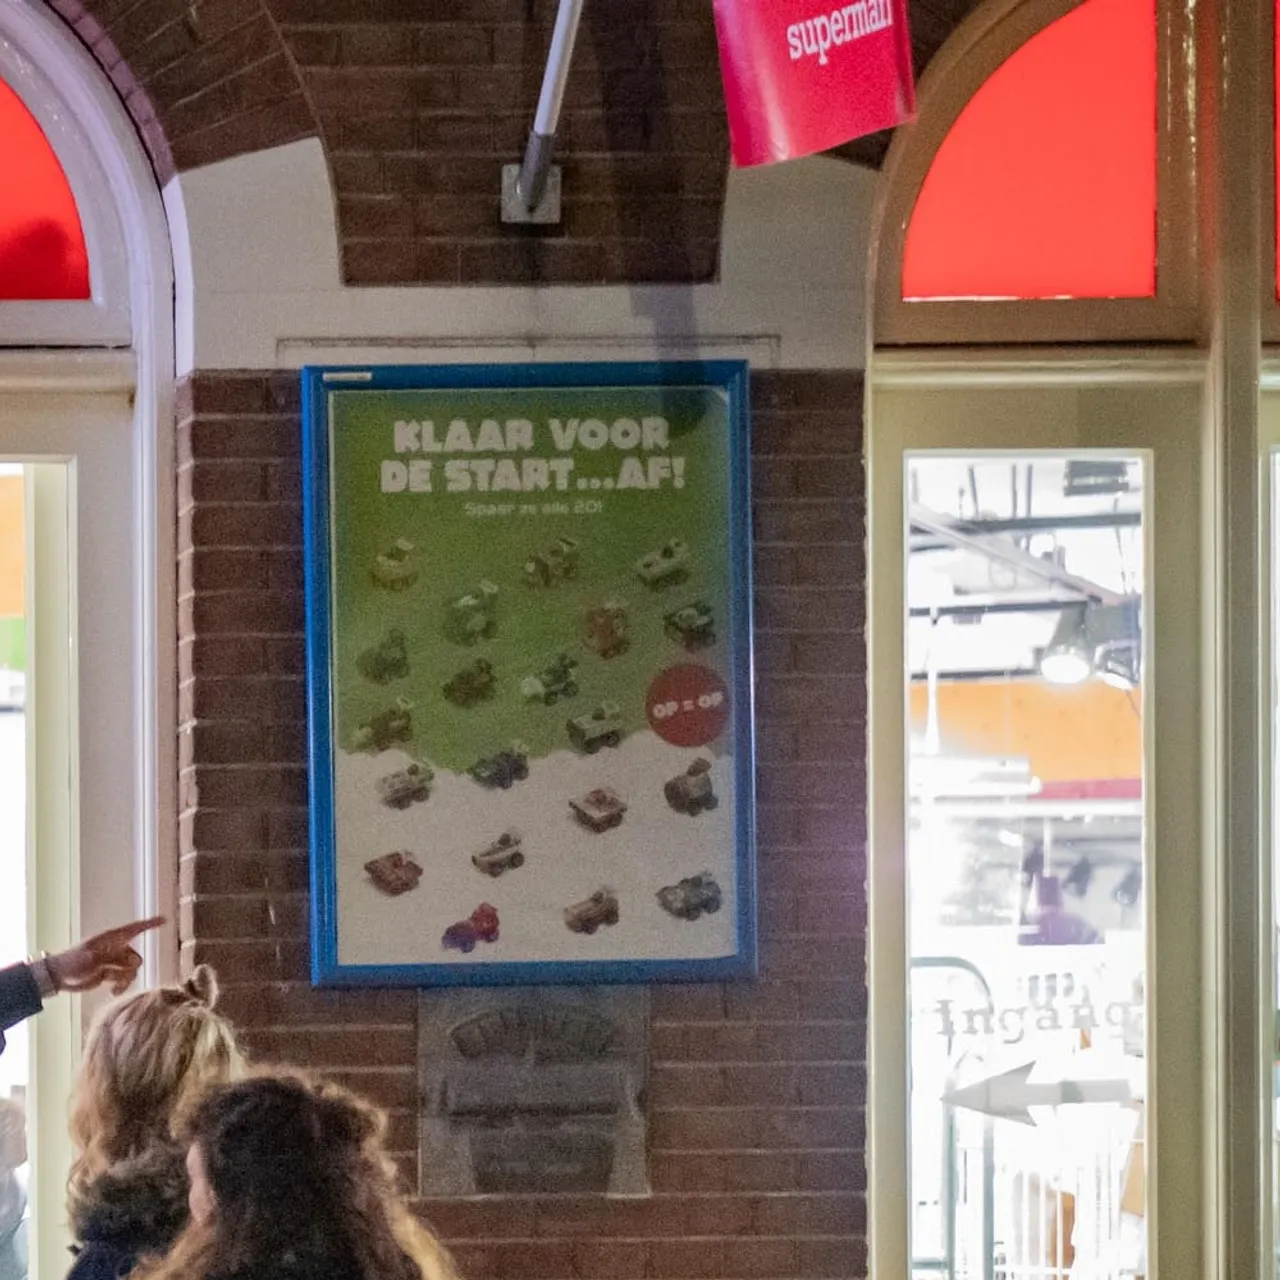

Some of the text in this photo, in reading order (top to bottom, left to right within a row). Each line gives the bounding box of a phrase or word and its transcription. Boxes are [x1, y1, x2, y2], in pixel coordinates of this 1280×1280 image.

[393, 416, 671, 453] KLAAR VOOR
[380, 458, 433, 493] DE
[652, 700, 679, 719] OP
[698, 691, 724, 709] OP
